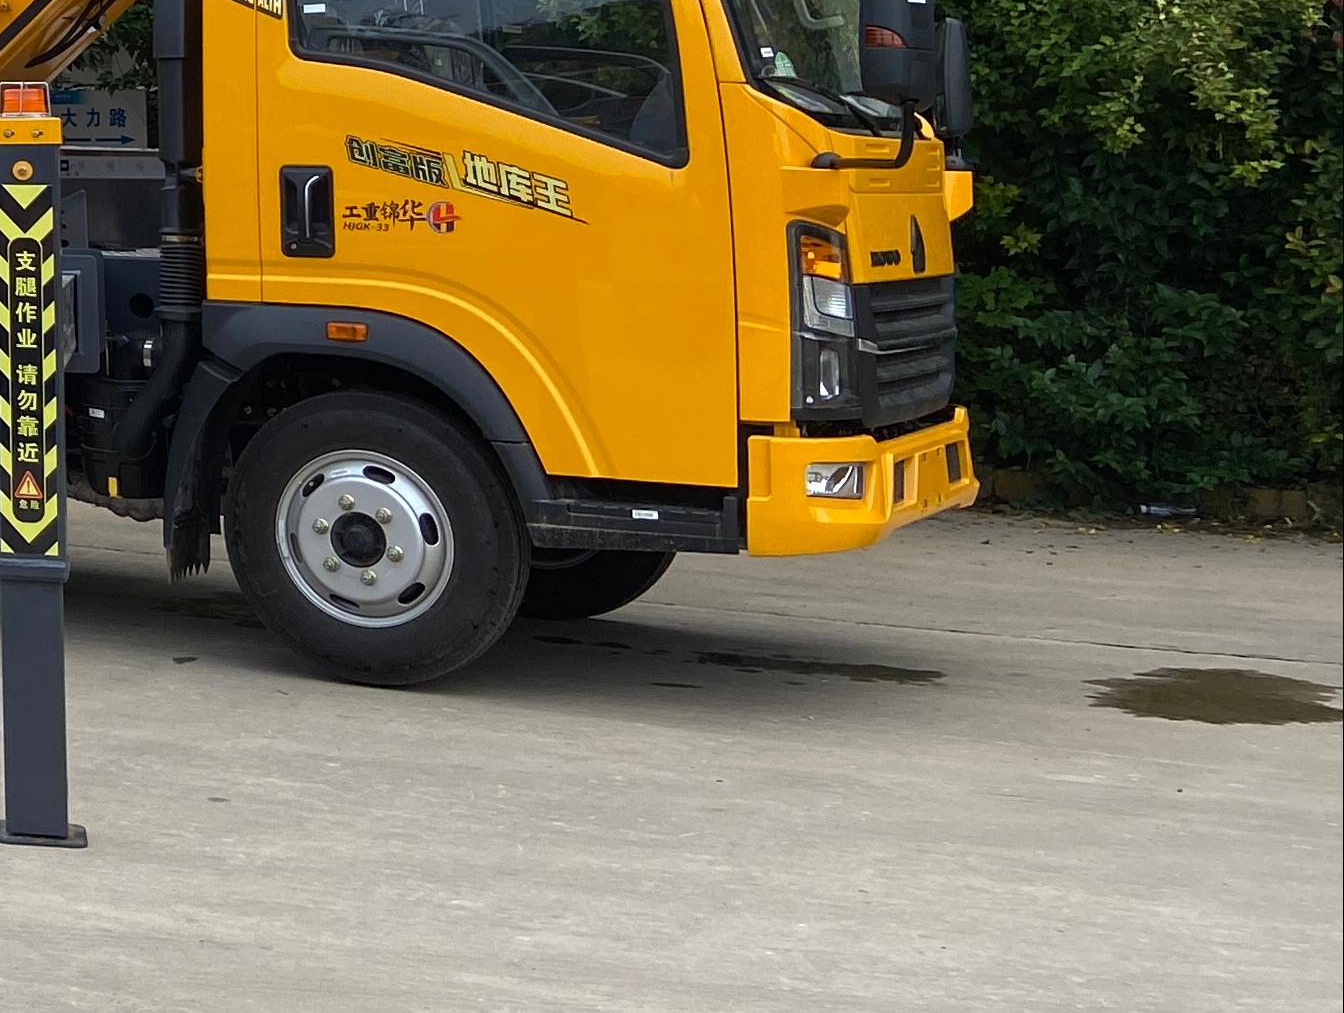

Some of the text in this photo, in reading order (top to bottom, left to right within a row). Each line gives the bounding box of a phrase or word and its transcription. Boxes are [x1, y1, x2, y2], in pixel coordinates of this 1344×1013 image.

[61, 107, 127, 128] 大力路
[462, 150, 573, 218] 地库王
[14, 250, 39, 464] 支腿作业 请勿靠近
